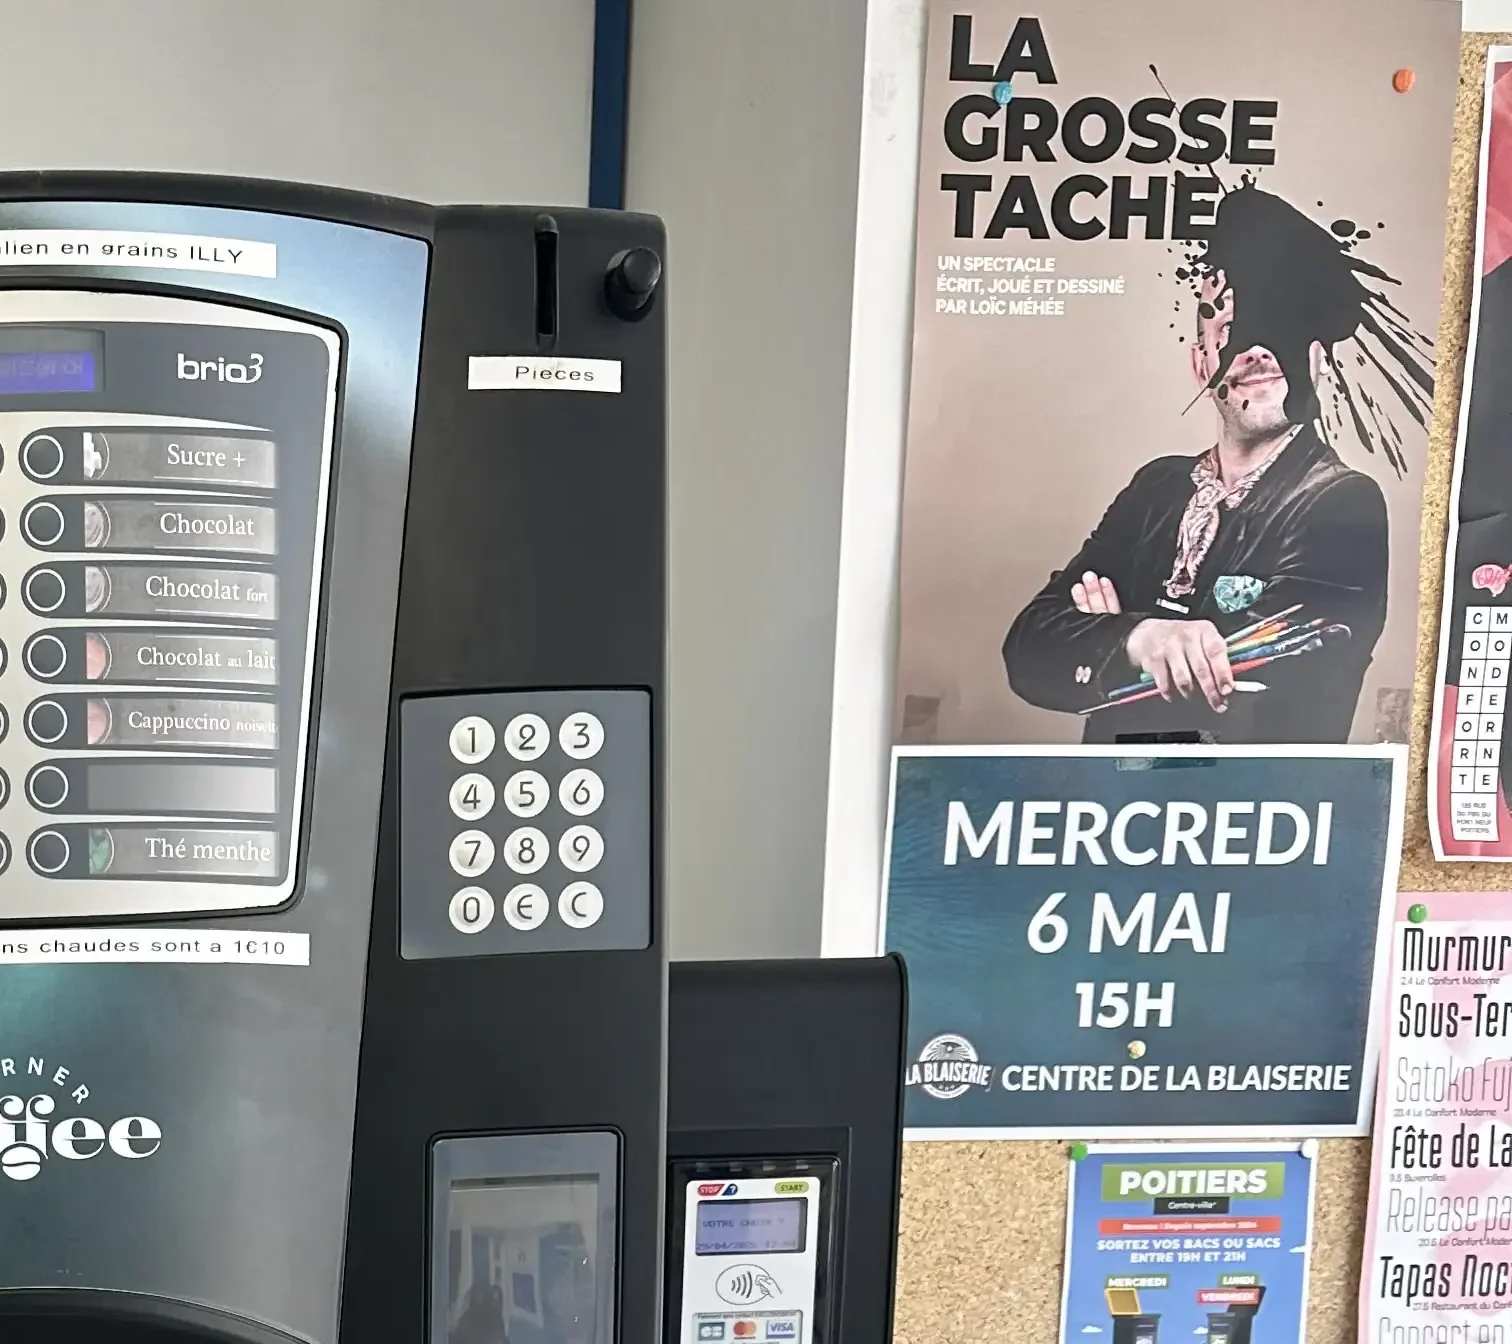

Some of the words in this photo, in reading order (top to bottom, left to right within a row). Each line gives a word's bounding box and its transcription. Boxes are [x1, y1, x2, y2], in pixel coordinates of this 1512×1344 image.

[949, 15, 1057, 84] LA
[944, 95, 1278, 165] GROSSE
[940, 174, 1219, 241] TACHE
[61, 242, 89, 255] en
[101, 244, 178, 261] grains
[188, 246, 244, 264] ILLY
[937, 256, 960, 271] UN
[964, 257, 1055, 272] SPECTACLE
[937, 274, 984, 295] ÉCRIT,
[987, 275, 1031, 294] JOUÉ
[1034, 279, 1054, 294] ET
[1057, 276, 1124, 294] DESSINÉ
[936, 299, 967, 315] PAR
[970, 296, 1006, 315] LOÏC
[515, 365, 594, 382] Pieces
[166, 444, 225, 468] Sucre
[159, 511, 255, 537] Chocolat
[145, 575, 240, 600] Chocolat
[136, 646, 222, 668] Chocolat
[227, 656, 242, 667] au
[128, 710, 230, 738] Cappuccino
[518, 724, 536, 751] 2
[573, 722, 589, 749] 3
[467, 726, 477, 753] 1
[462, 783, 481, 809] 4
[519, 781, 535, 808] 5
[573, 779, 590, 806] 6
[943, 801, 1333, 866] MERCREDI
[145, 838, 186, 860] Thé
[193, 839, 271, 863] menthe
[464, 840, 481, 867] 7
[518, 837, 535, 864] 8
[572, 835, 590, 862] 9
[463, 896, 480, 923] 0
[571, 891, 587, 918] C
[1027, 893, 1068, 954] 6
[1088, 892, 1231, 954] MAI
[38, 938, 141, 955] chaudes
[150, 940, 202, 954] sont
[1075, 982, 1174, 1028] 15H
[905, 1064, 922, 1086] LA
[924, 1062, 991, 1086] BLAISERIE
[1002, 1065, 1111, 1092] CENTRE
[1121, 1066, 1160, 1091] DE
[1166, 1066, 1202, 1091] LA
[1207, 1065, 1352, 1091] BLAISERIE
[1396, 1056, 1474, 1102] Satoko
[1391, 1125, 1442, 1169] Fête
[1451, 1123, 1479, 1168] de
[779, 1183, 803, 1192] START
[1120, 1169, 1268, 1196] POITIERS
[1387, 1187, 1478, 1233] Release
[1097, 1239, 1149, 1251] SORTEZ
[1153, 1239, 1180, 1250] VOS
[1184, 1239, 1220, 1250] BACS
[1223, 1238, 1243, 1249] OU
[1246, 1238, 1280, 1249] SACS
[1130, 1252, 1173, 1263] ENTRE
[1204, 1252, 1221, 1262] ET
[1380, 1256, 1452, 1307] Tapas
[770, 1322, 795, 1333] VISA
